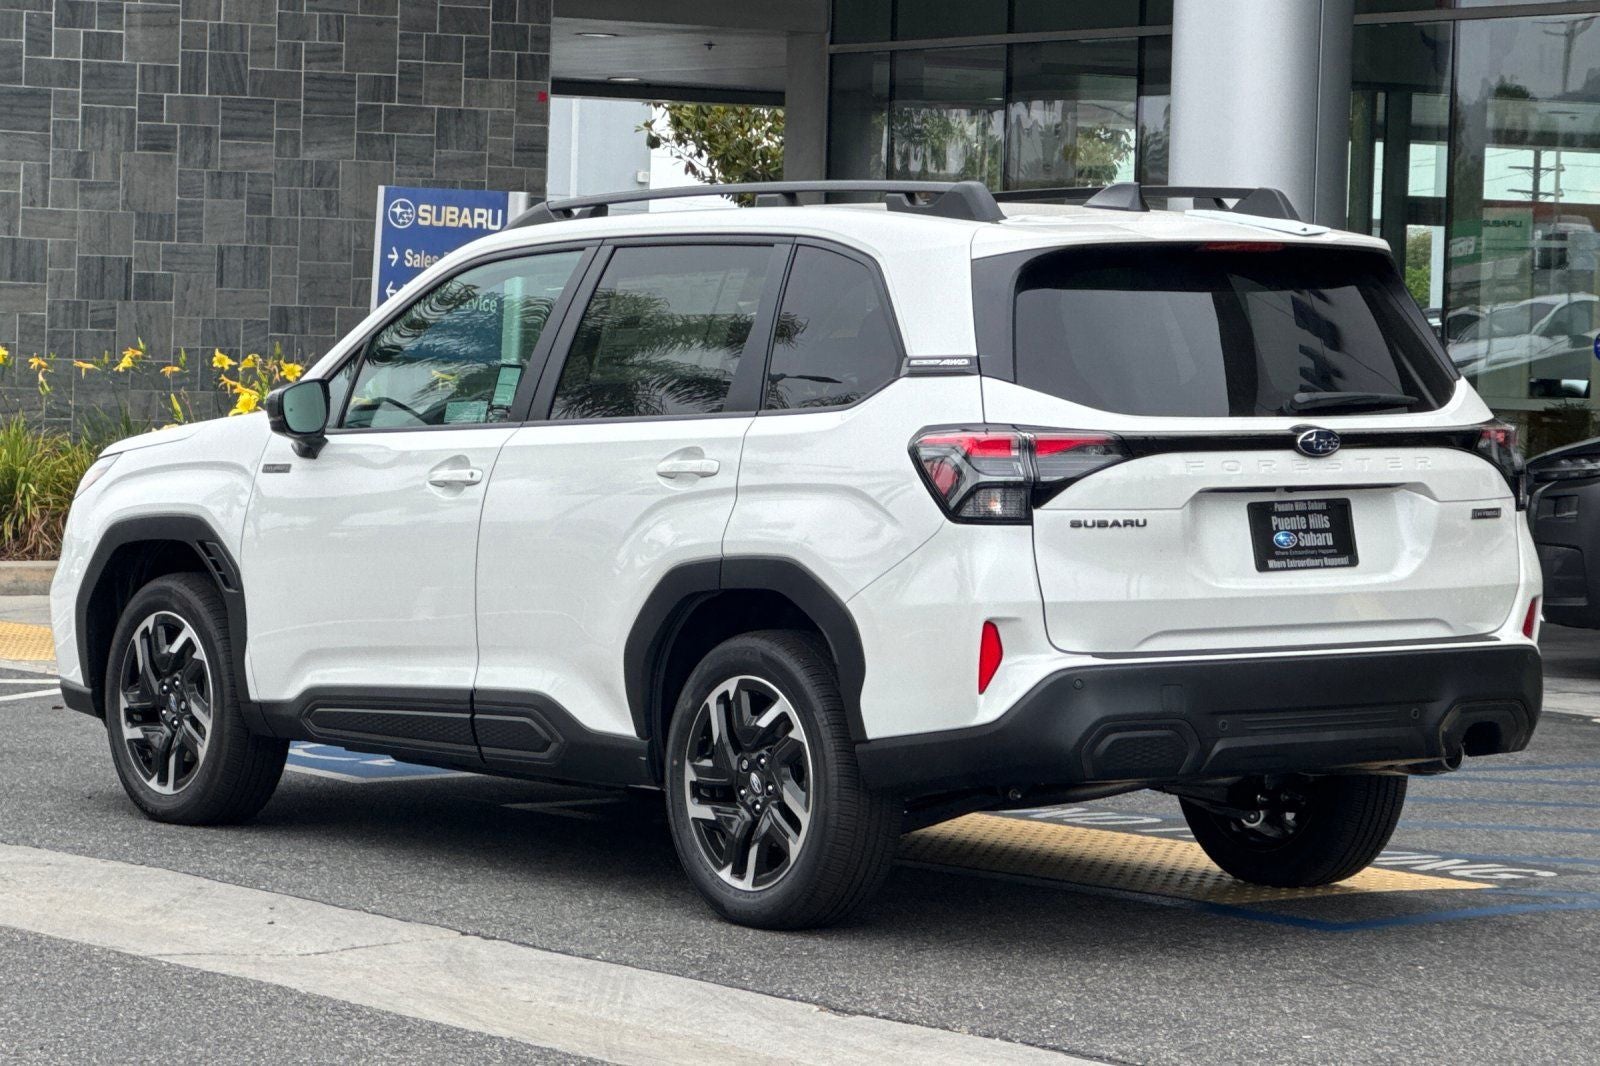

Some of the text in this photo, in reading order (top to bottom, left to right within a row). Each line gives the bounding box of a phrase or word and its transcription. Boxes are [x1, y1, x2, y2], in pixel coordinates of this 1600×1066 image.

[418, 204, 502, 231] SUBARU
[1483, 219, 1522, 228] SUBARU
[1184, 455, 1434, 475] FORESTER
[1069, 518, 1147, 528] SUBARU
[1271, 513, 1331, 531] Puente Hills
[1297, 532, 1334, 547] Subaru
[1267, 559, 1287, 569] Where
